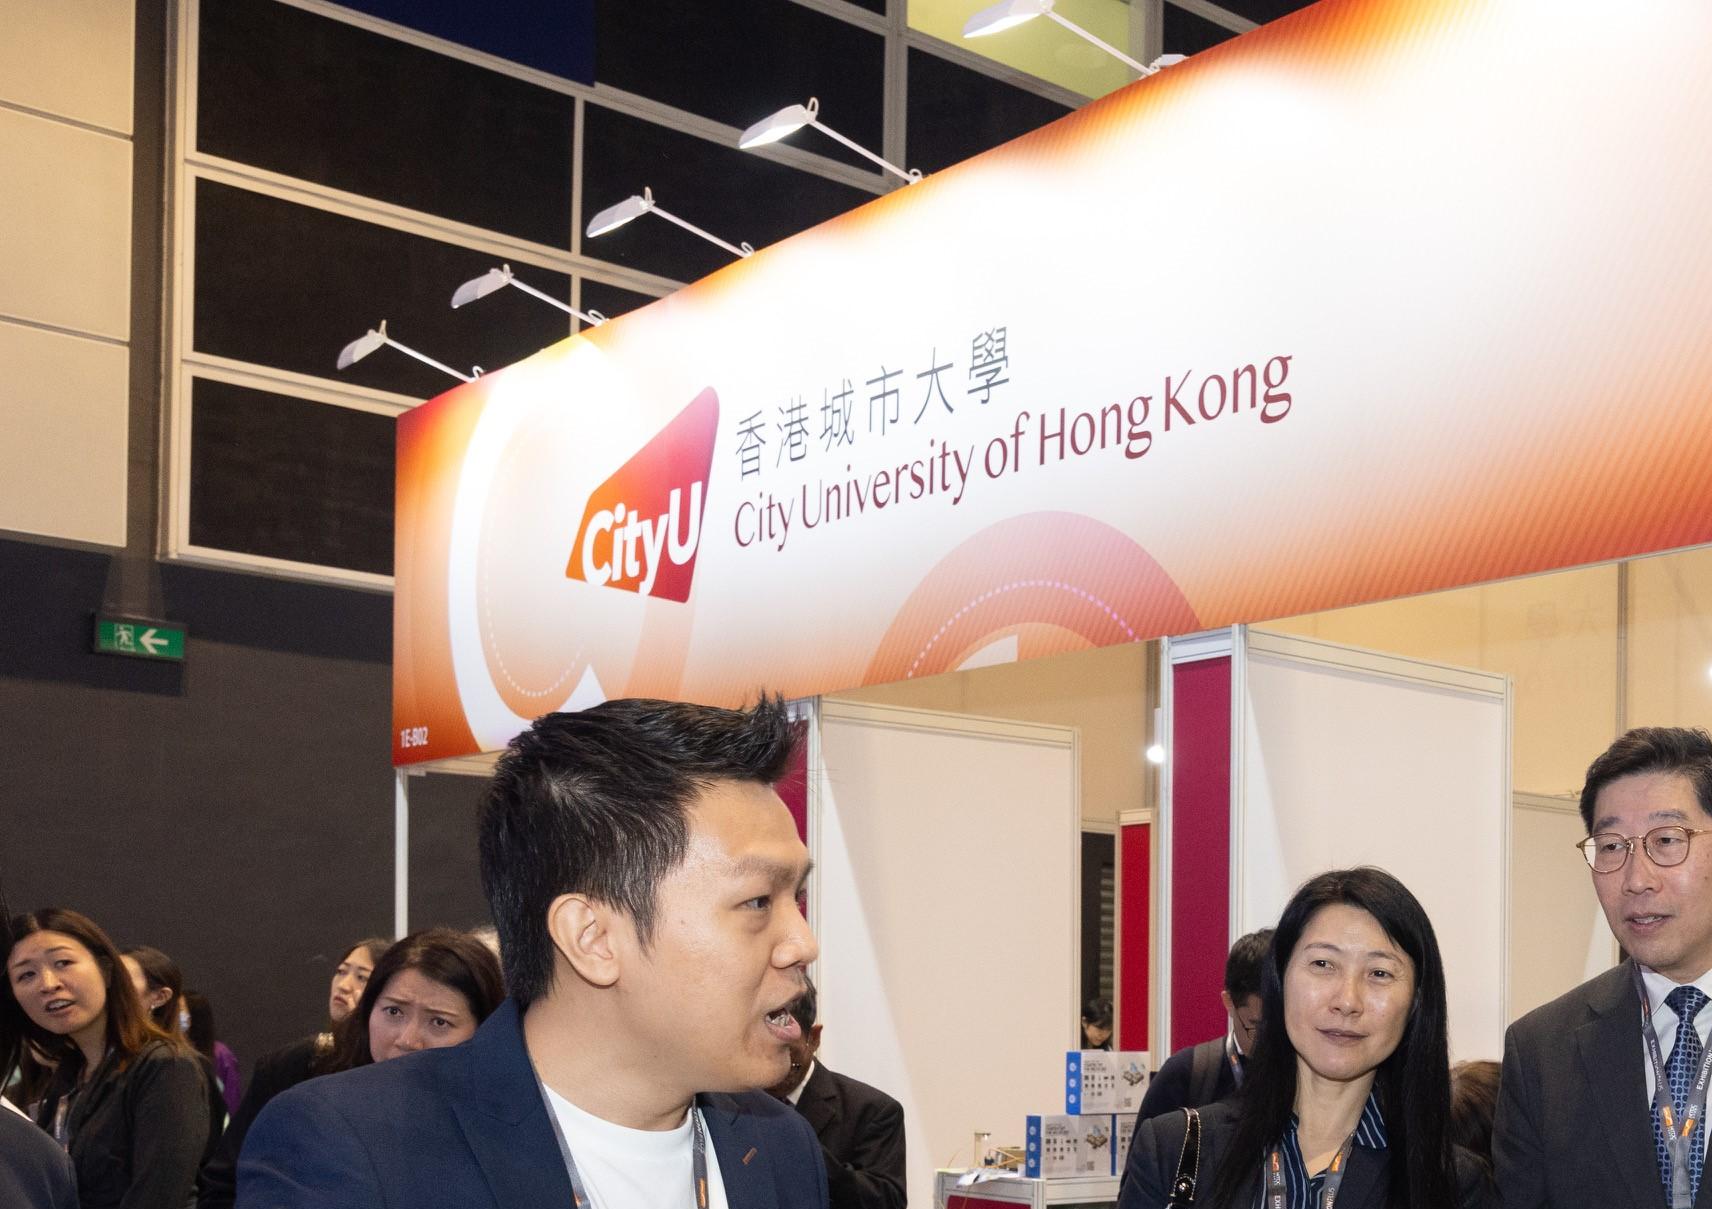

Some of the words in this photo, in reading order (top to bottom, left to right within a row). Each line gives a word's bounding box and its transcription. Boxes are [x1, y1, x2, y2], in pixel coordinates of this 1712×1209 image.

[735, 326, 1010, 482] 香港城市大學
[735, 491, 795, 552] City
[802, 438, 974, 529] University
[984, 411, 1031, 479] of
[1039, 395, 1153, 466] Hong
[1164, 355, 1293, 432] Kong
[582, 481, 702, 596] CityU
